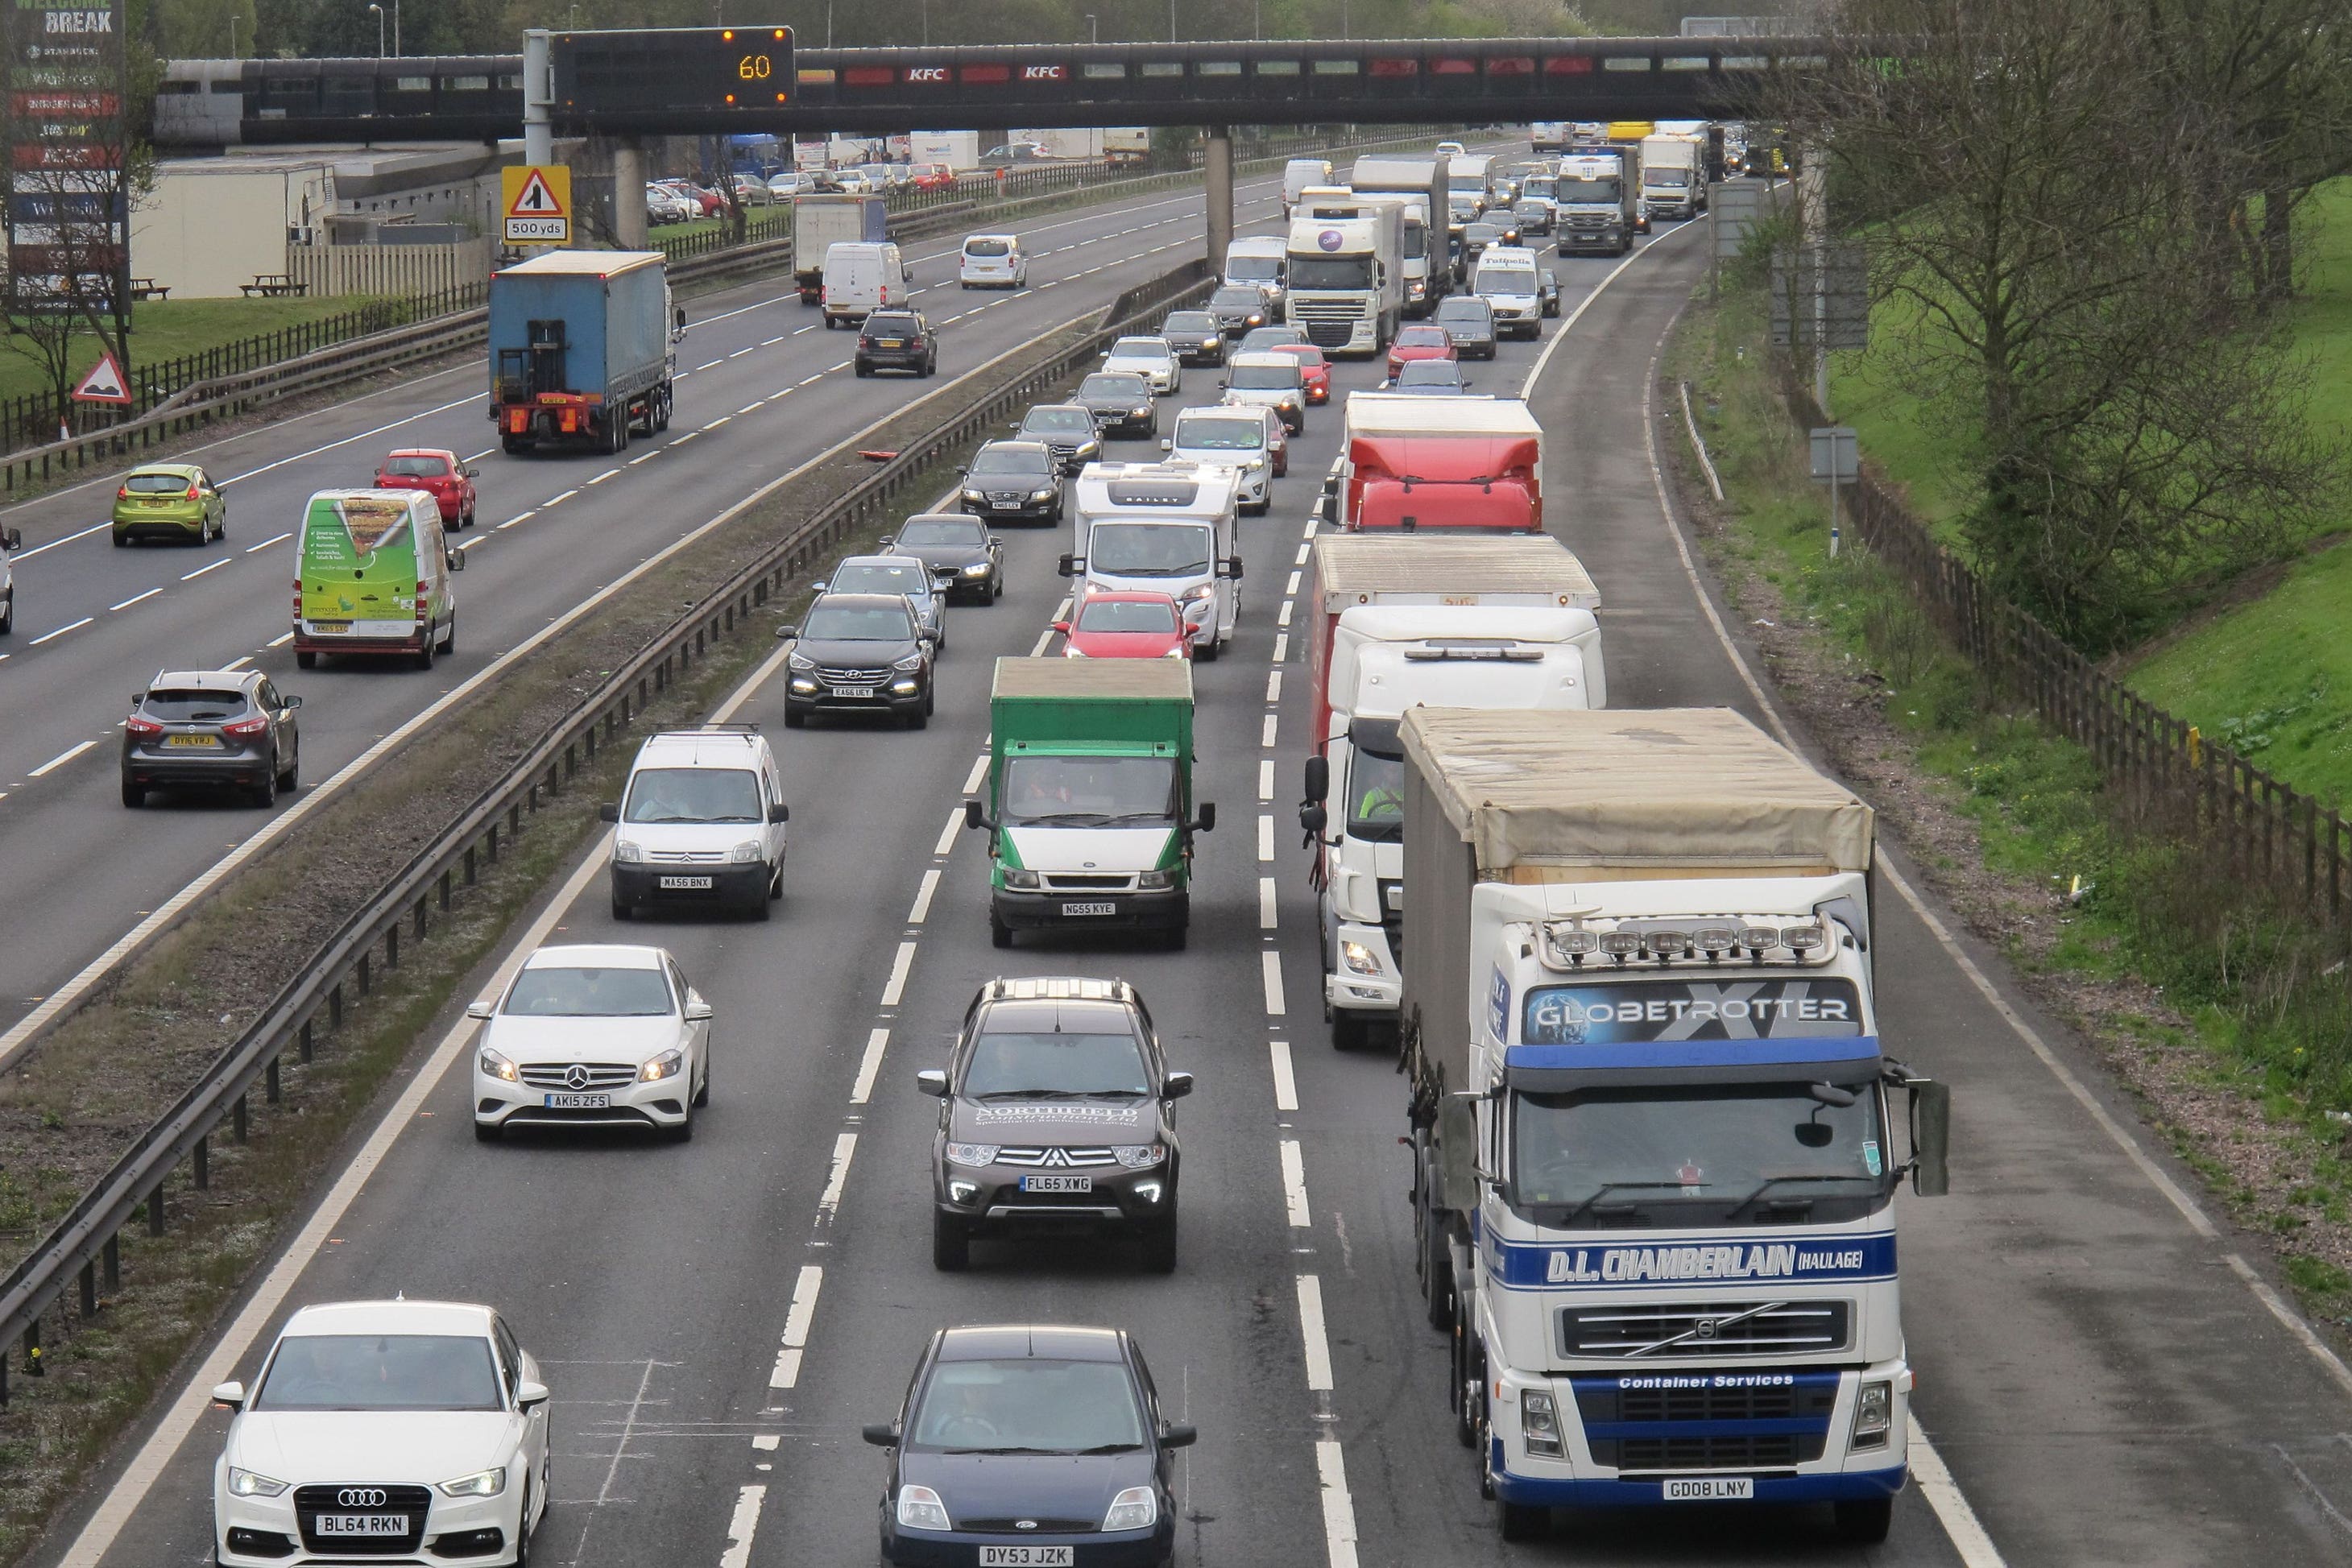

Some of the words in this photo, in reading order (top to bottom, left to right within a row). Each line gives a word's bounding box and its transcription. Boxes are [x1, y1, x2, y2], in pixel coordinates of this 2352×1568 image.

[46, 11, 112, 33] BREAK
[739, 55, 770, 78] 60
[1025, 66, 1060, 78] KFC
[909, 68, 944, 81] KFC
[512, 223, 538, 234] 500
[540, 223, 561, 235] yds
[690, 878, 708, 887] BNX
[1066, 905, 1091, 915] NG55
[1093, 904, 1112, 913] KYE
[1536, 998, 1849, 1026] GLOBETROTTER
[555, 1095, 580, 1107] AK15
[582, 1096, 605, 1107] ZFS
[1027, 1177, 1061, 1190] FL65
[1064, 1177, 1089, 1190] XWG
[1547, 1249, 1600, 1283] D.L.
[1601, 1244, 1797, 1282] CHAMBERLAIN
[1798, 1249, 1864, 1271] (HAULAGE)
[1619, 1376, 1709, 1389] Container
[1714, 1374, 1794, 1387] Services
[1670, 1482, 1712, 1497] GD08
[1716, 1482, 1747, 1496] LNY
[324, 1516, 365, 1533] BL64
[370, 1516, 403, 1532] RKN
[986, 1548, 1030, 1564] DY53
[1033, 1548, 1067, 1564] JZK
